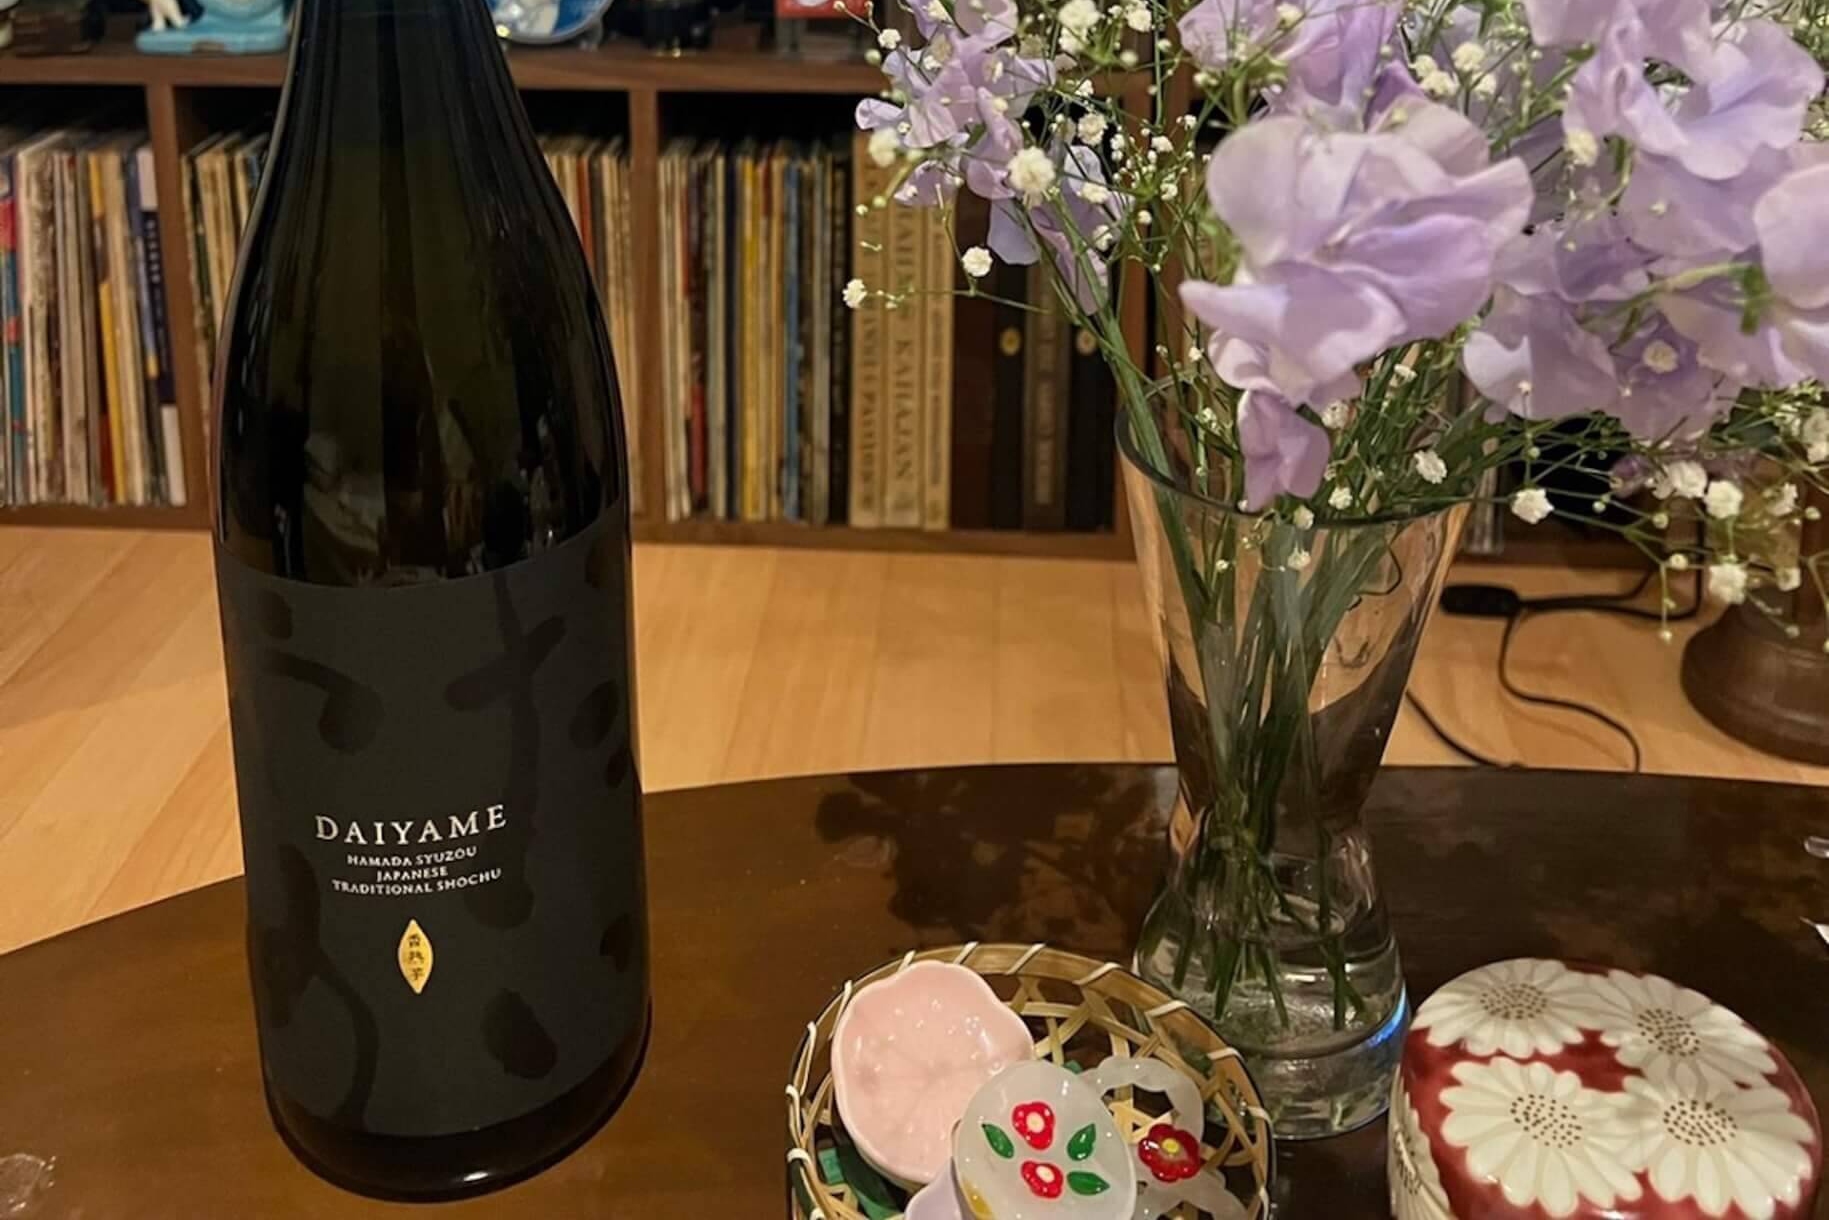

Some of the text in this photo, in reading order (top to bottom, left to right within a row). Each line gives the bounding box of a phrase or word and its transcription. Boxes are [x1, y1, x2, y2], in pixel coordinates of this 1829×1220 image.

[315, 804, 507, 845] DAIYAME
[347, 846, 477, 867] HAMADA SYUZOU
[332, 868, 502, 896] TRADITIONAL SHOCHU
[376, 866, 448, 883] JAPANESE
